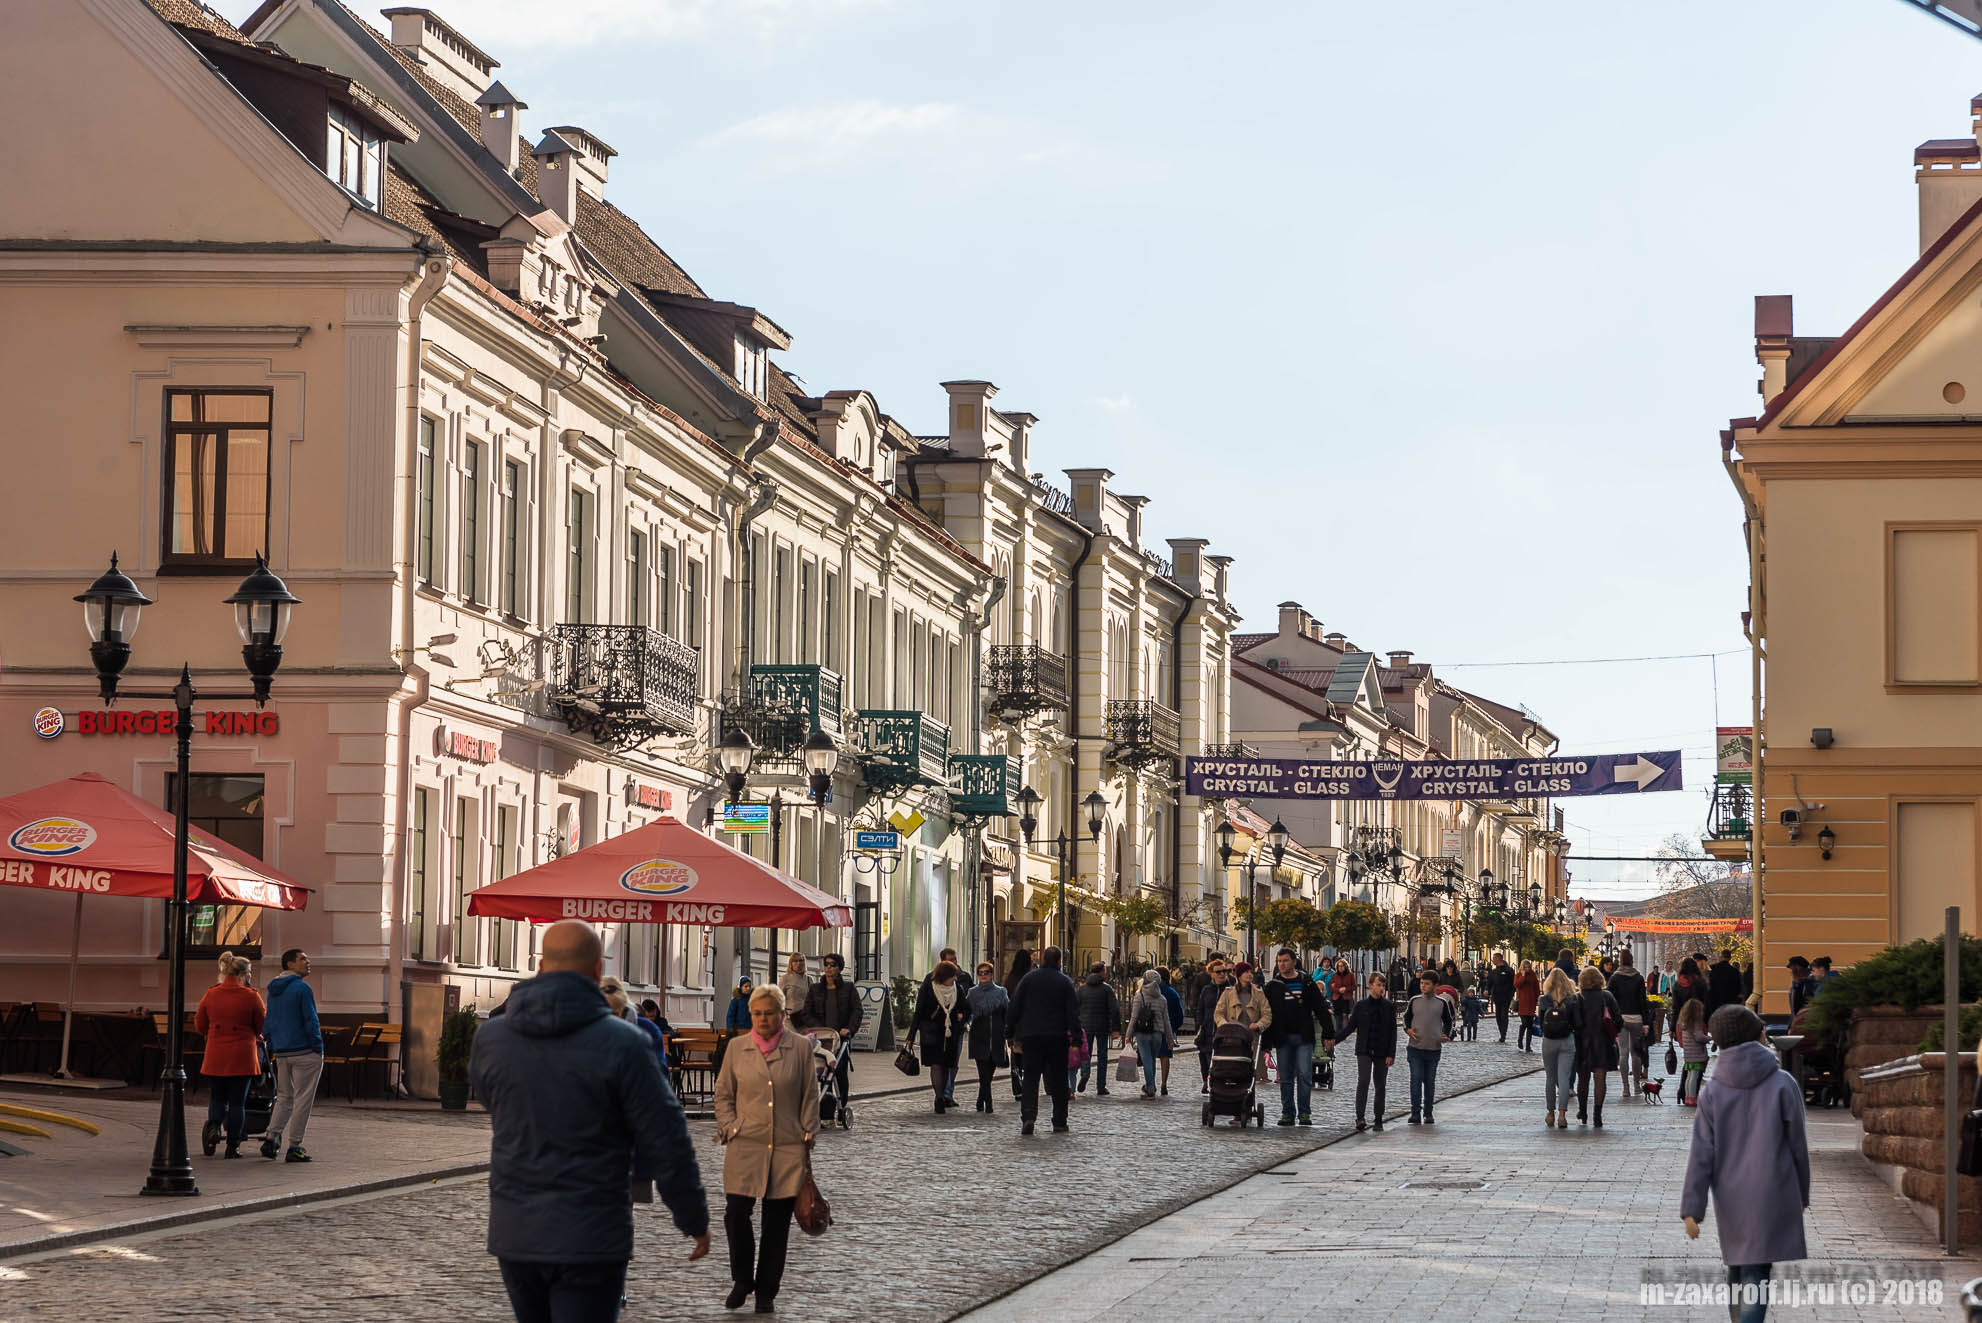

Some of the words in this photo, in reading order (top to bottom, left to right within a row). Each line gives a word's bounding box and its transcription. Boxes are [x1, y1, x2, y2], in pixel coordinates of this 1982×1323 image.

[36, 712, 59, 724] BURGER
[37, 717, 61, 731] KING
[79, 711, 178, 734] BURGE
[205, 711, 279, 735] KING
[453, 731, 480, 760] BURGER
[1192, 761, 1283, 777] ХРУСТАЛЬ
[1298, 765, 1367, 779] СТЕКЛО
[1410, 763, 1502, 779] ХРУСТАЛЬ
[1517, 761, 1588, 777] СТЕКЛО
[1202, 778, 1279, 793] CRYSTAL
[1294, 782, 1350, 795] GLASS
[1421, 780, 1500, 795] CRYSTAL
[1514, 778, 1571, 792] GLASS
[16, 832, 88, 845] KING
[22, 826, 89, 837] BURGER
[860, 835, 894, 843] СЭЛТИ
[48, 866, 111, 892] KING
[629, 868, 689, 881] BURGER
[630, 874, 689, 888] KING
[562, 899, 652, 920] BURGER
[666, 903, 725, 924] KING
